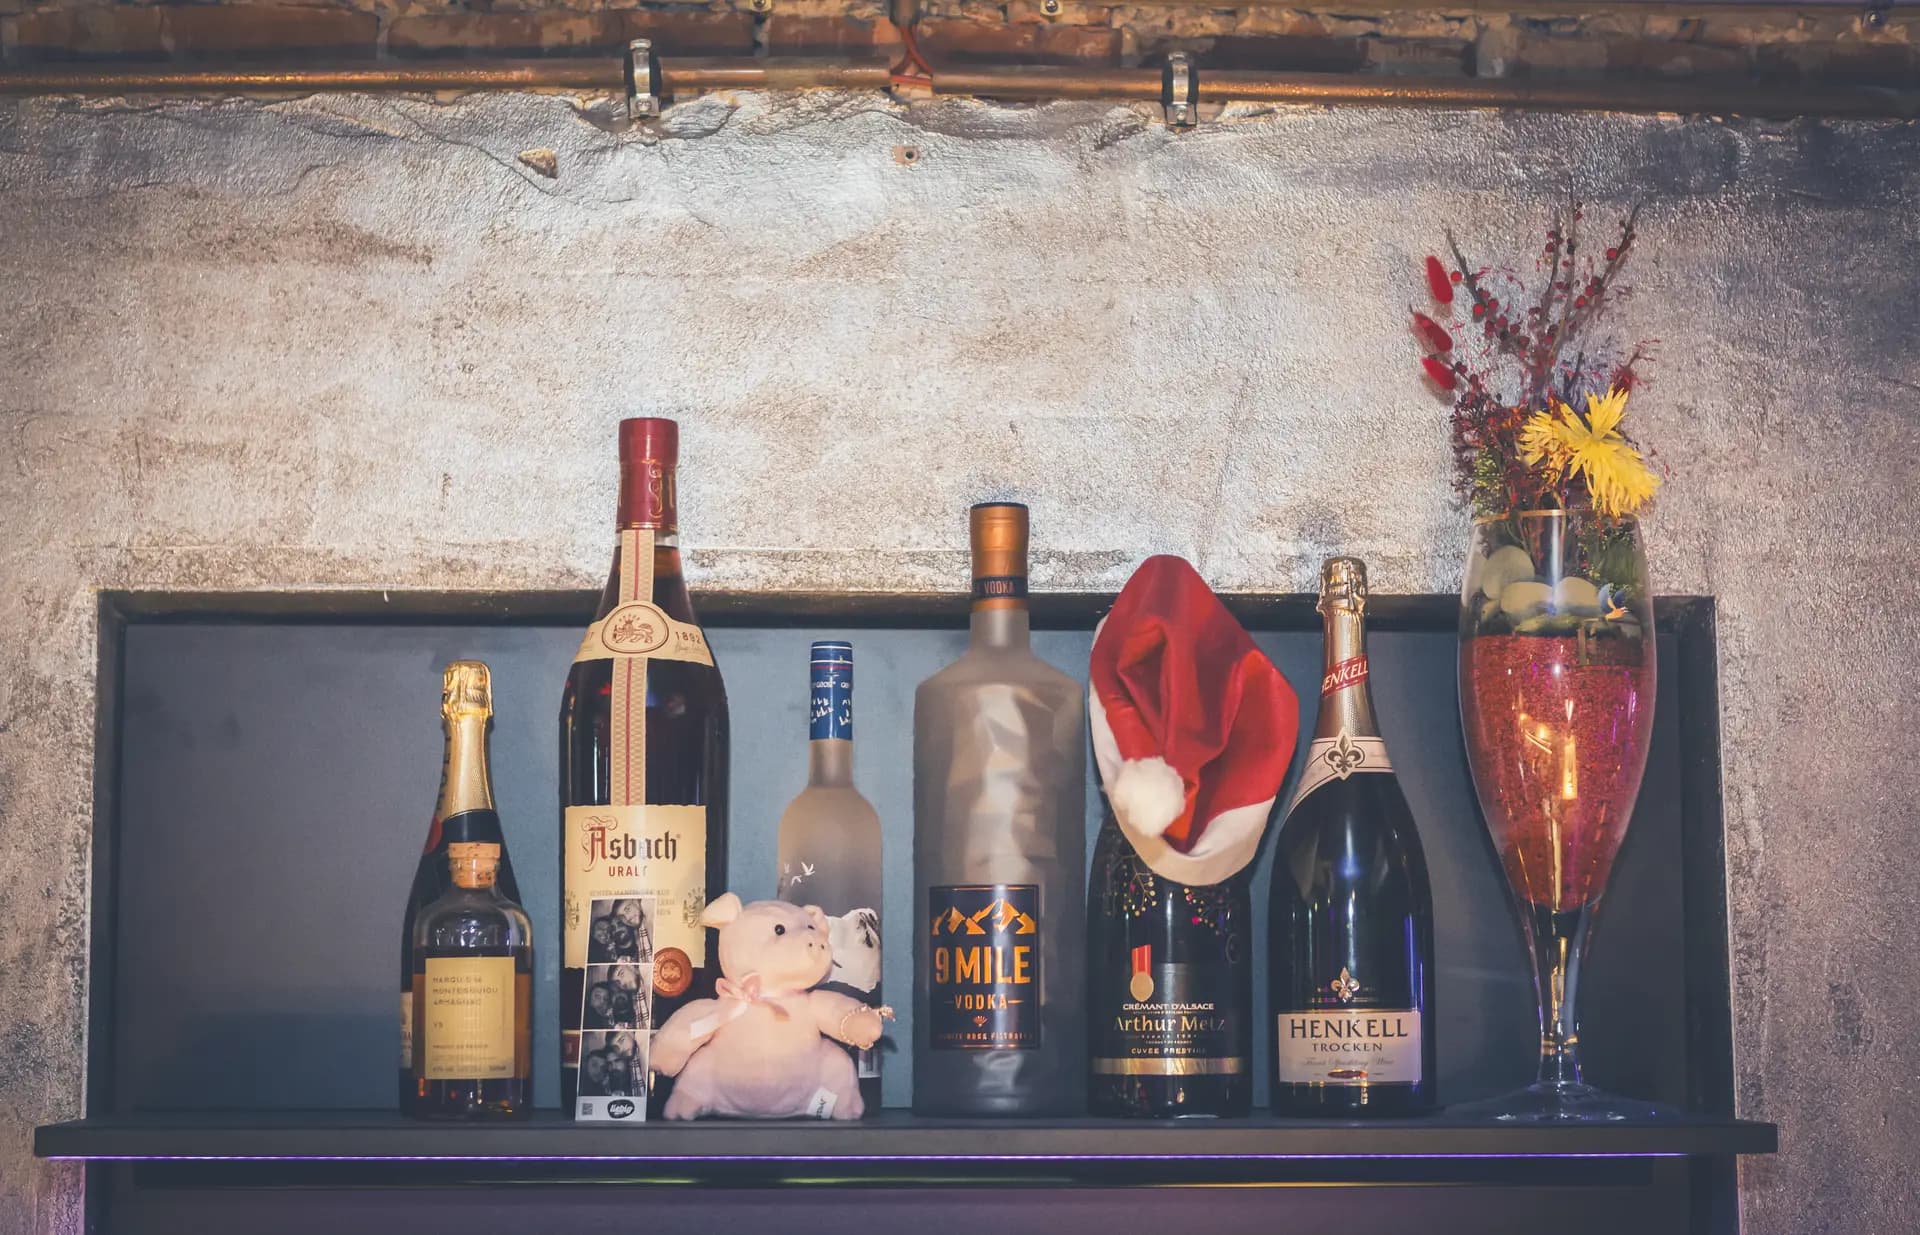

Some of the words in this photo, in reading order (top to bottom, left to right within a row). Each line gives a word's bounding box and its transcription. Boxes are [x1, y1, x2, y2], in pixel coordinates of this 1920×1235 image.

[984, 581, 1015, 594] VODKA
[582, 817, 677, 866] Asbach
[955, 994, 1008, 1010] VODKA
[1122, 1002, 1168, 1011] CRÉMANT
[1171, 1002, 1215, 1011] D'ALSACE
[1114, 1015, 1177, 1032] Arthur
[1181, 1015, 1225, 1032] Metz
[1290, 1018, 1408, 1039] HENKELL
[1312, 1042, 1384, 1053] TROCKEN
